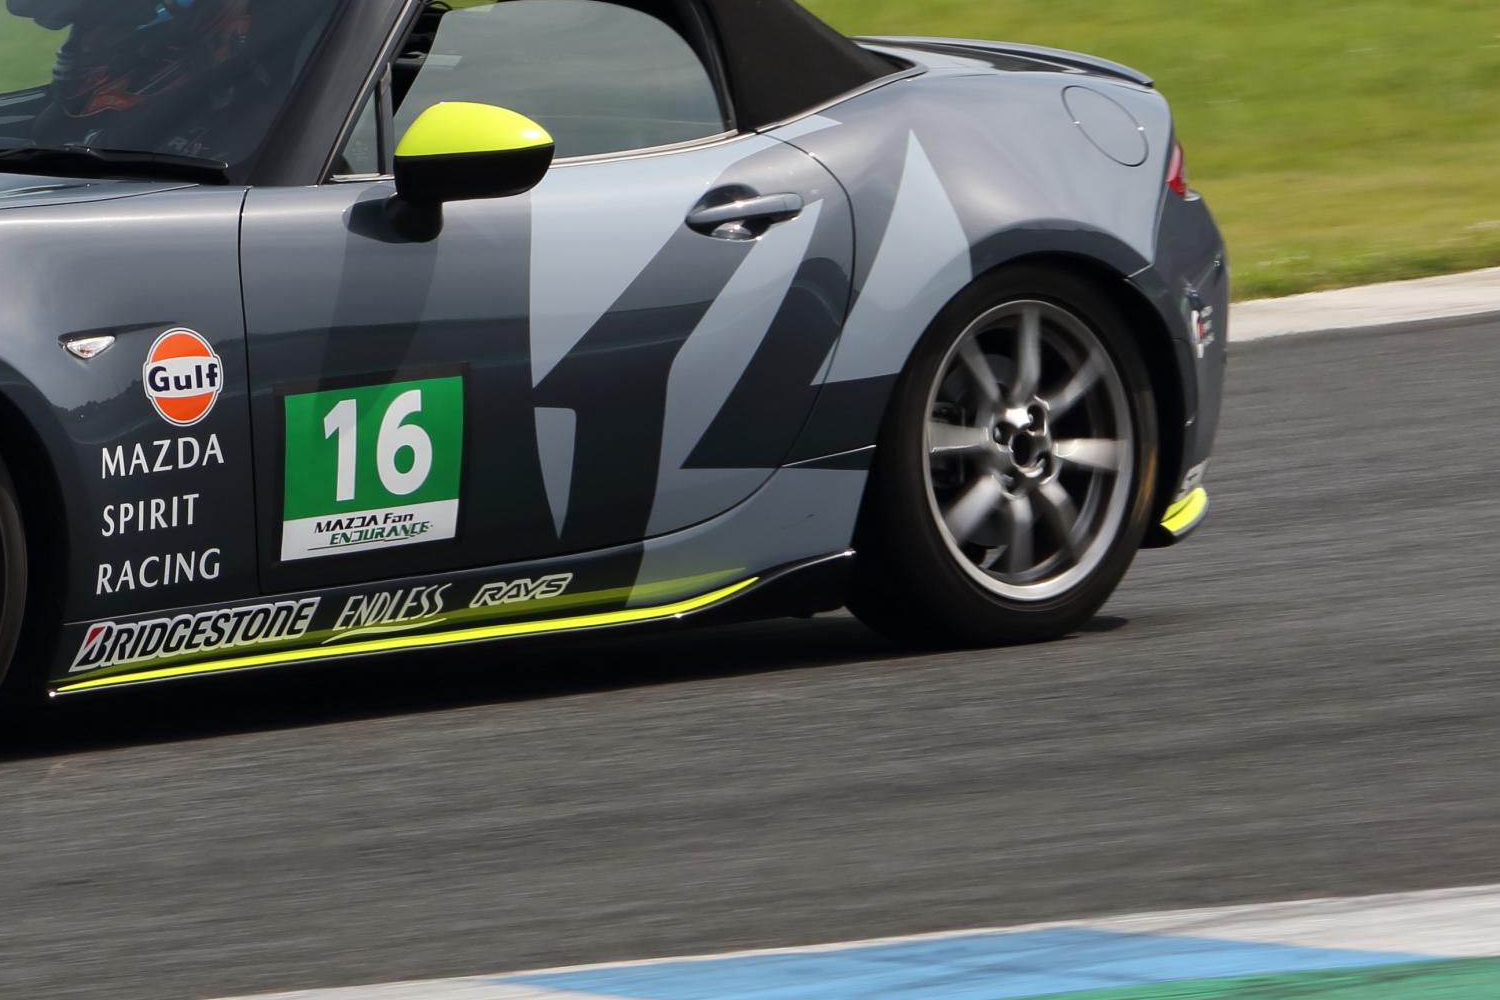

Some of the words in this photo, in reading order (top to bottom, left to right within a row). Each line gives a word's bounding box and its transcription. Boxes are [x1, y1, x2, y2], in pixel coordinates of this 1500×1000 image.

[148, 363, 219, 392] Gulf
[101, 433, 225, 479] MAZDA
[323, 389, 433, 502] 16
[101, 493, 200, 537] SPIRIT
[314, 514, 379, 534] MAZDA
[382, 512, 415, 525] Fan
[329, 521, 431, 545] ENDURANCE
[96, 548, 221, 595] RACING
[69, 597, 321, 672] BRIDGESTONE
[332, 583, 453, 632] ENDLESS
[468, 572, 574, 609] RAYS
